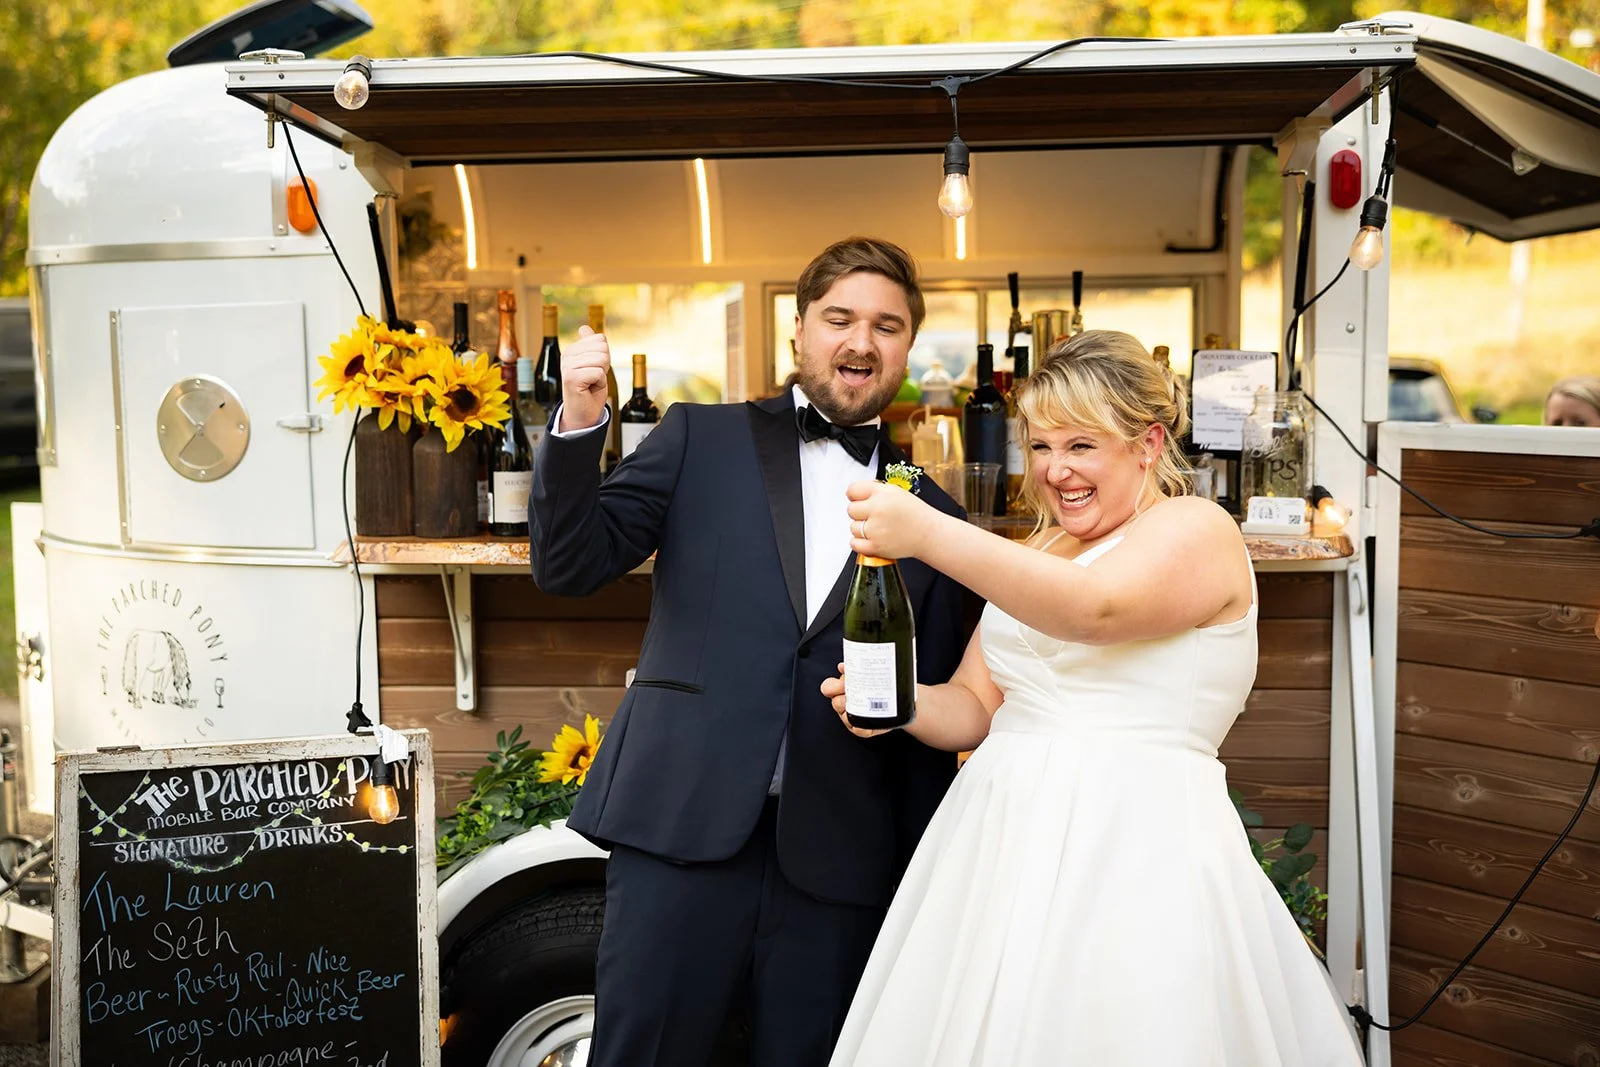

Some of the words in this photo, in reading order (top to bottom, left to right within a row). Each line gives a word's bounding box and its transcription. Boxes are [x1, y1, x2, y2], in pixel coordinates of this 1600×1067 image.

[189, 605, 228, 662] PONY
[259, 824, 344, 851] DRINKS
[83, 870, 150, 931] The
[165, 872, 275, 912] Lauren
[84, 934, 136, 976] The
[148, 916, 240, 961] Seth
[86, 981, 151, 1024] Beer
[173, 963, 240, 1006] Rusty
[246, 951, 283, 991] Rail
[307, 946, 351, 974] Nice
[357, 969, 405, 994] Beer
